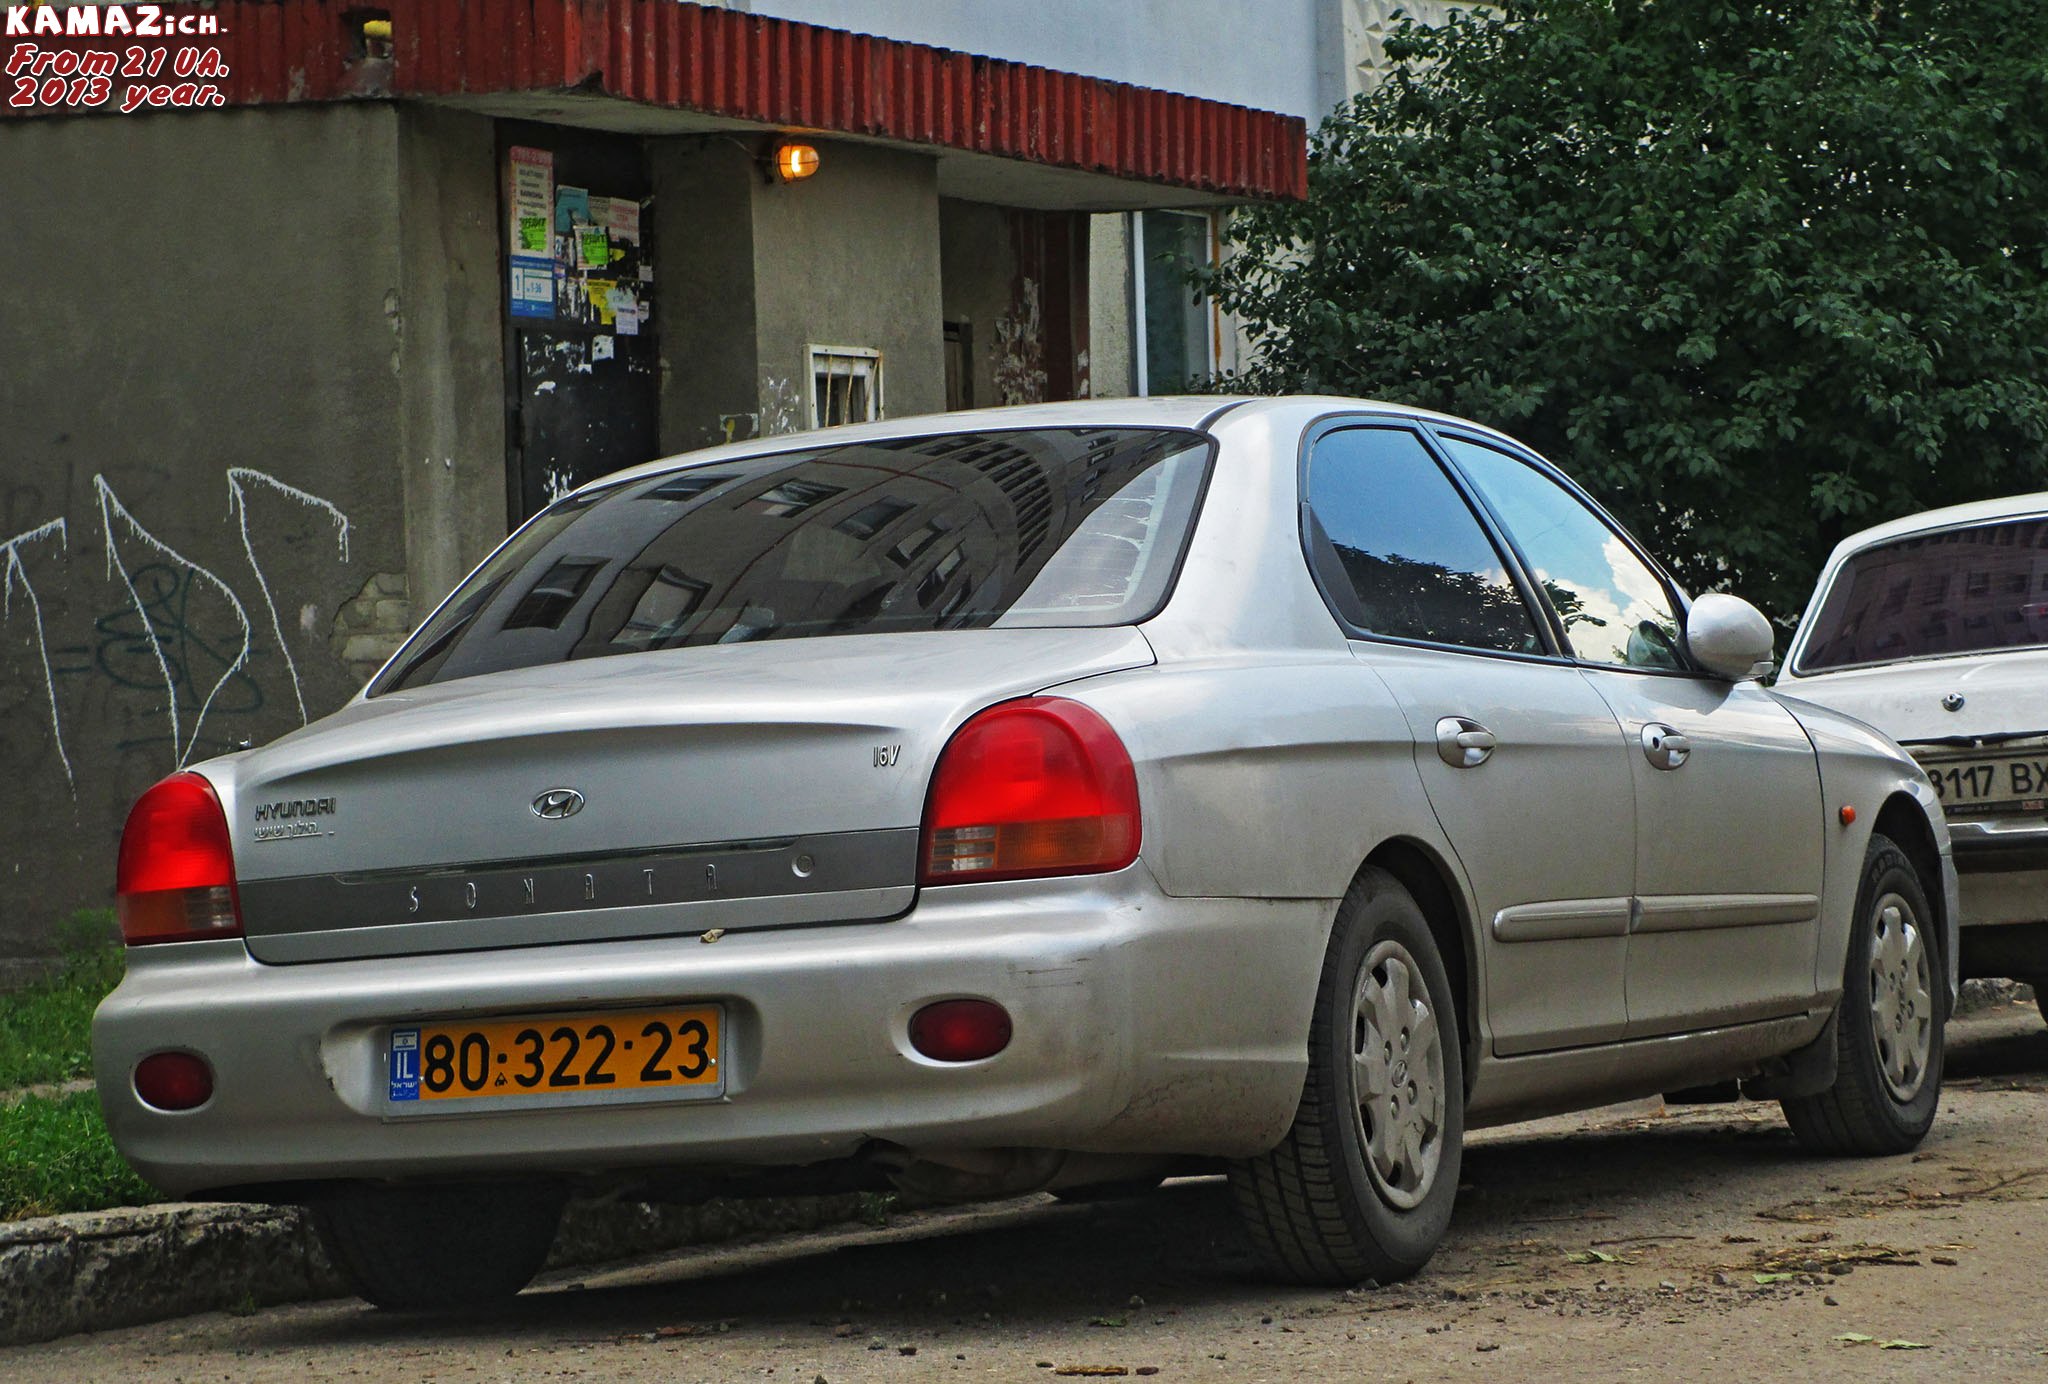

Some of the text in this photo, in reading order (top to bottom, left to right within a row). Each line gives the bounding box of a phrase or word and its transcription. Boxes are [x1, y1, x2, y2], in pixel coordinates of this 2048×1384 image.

[873, 744, 901, 768] 16V
[255, 797, 337, 821] HYUNDAI
[409, 863, 719, 913] SONATA
[396, 1051, 414, 1080] IL
